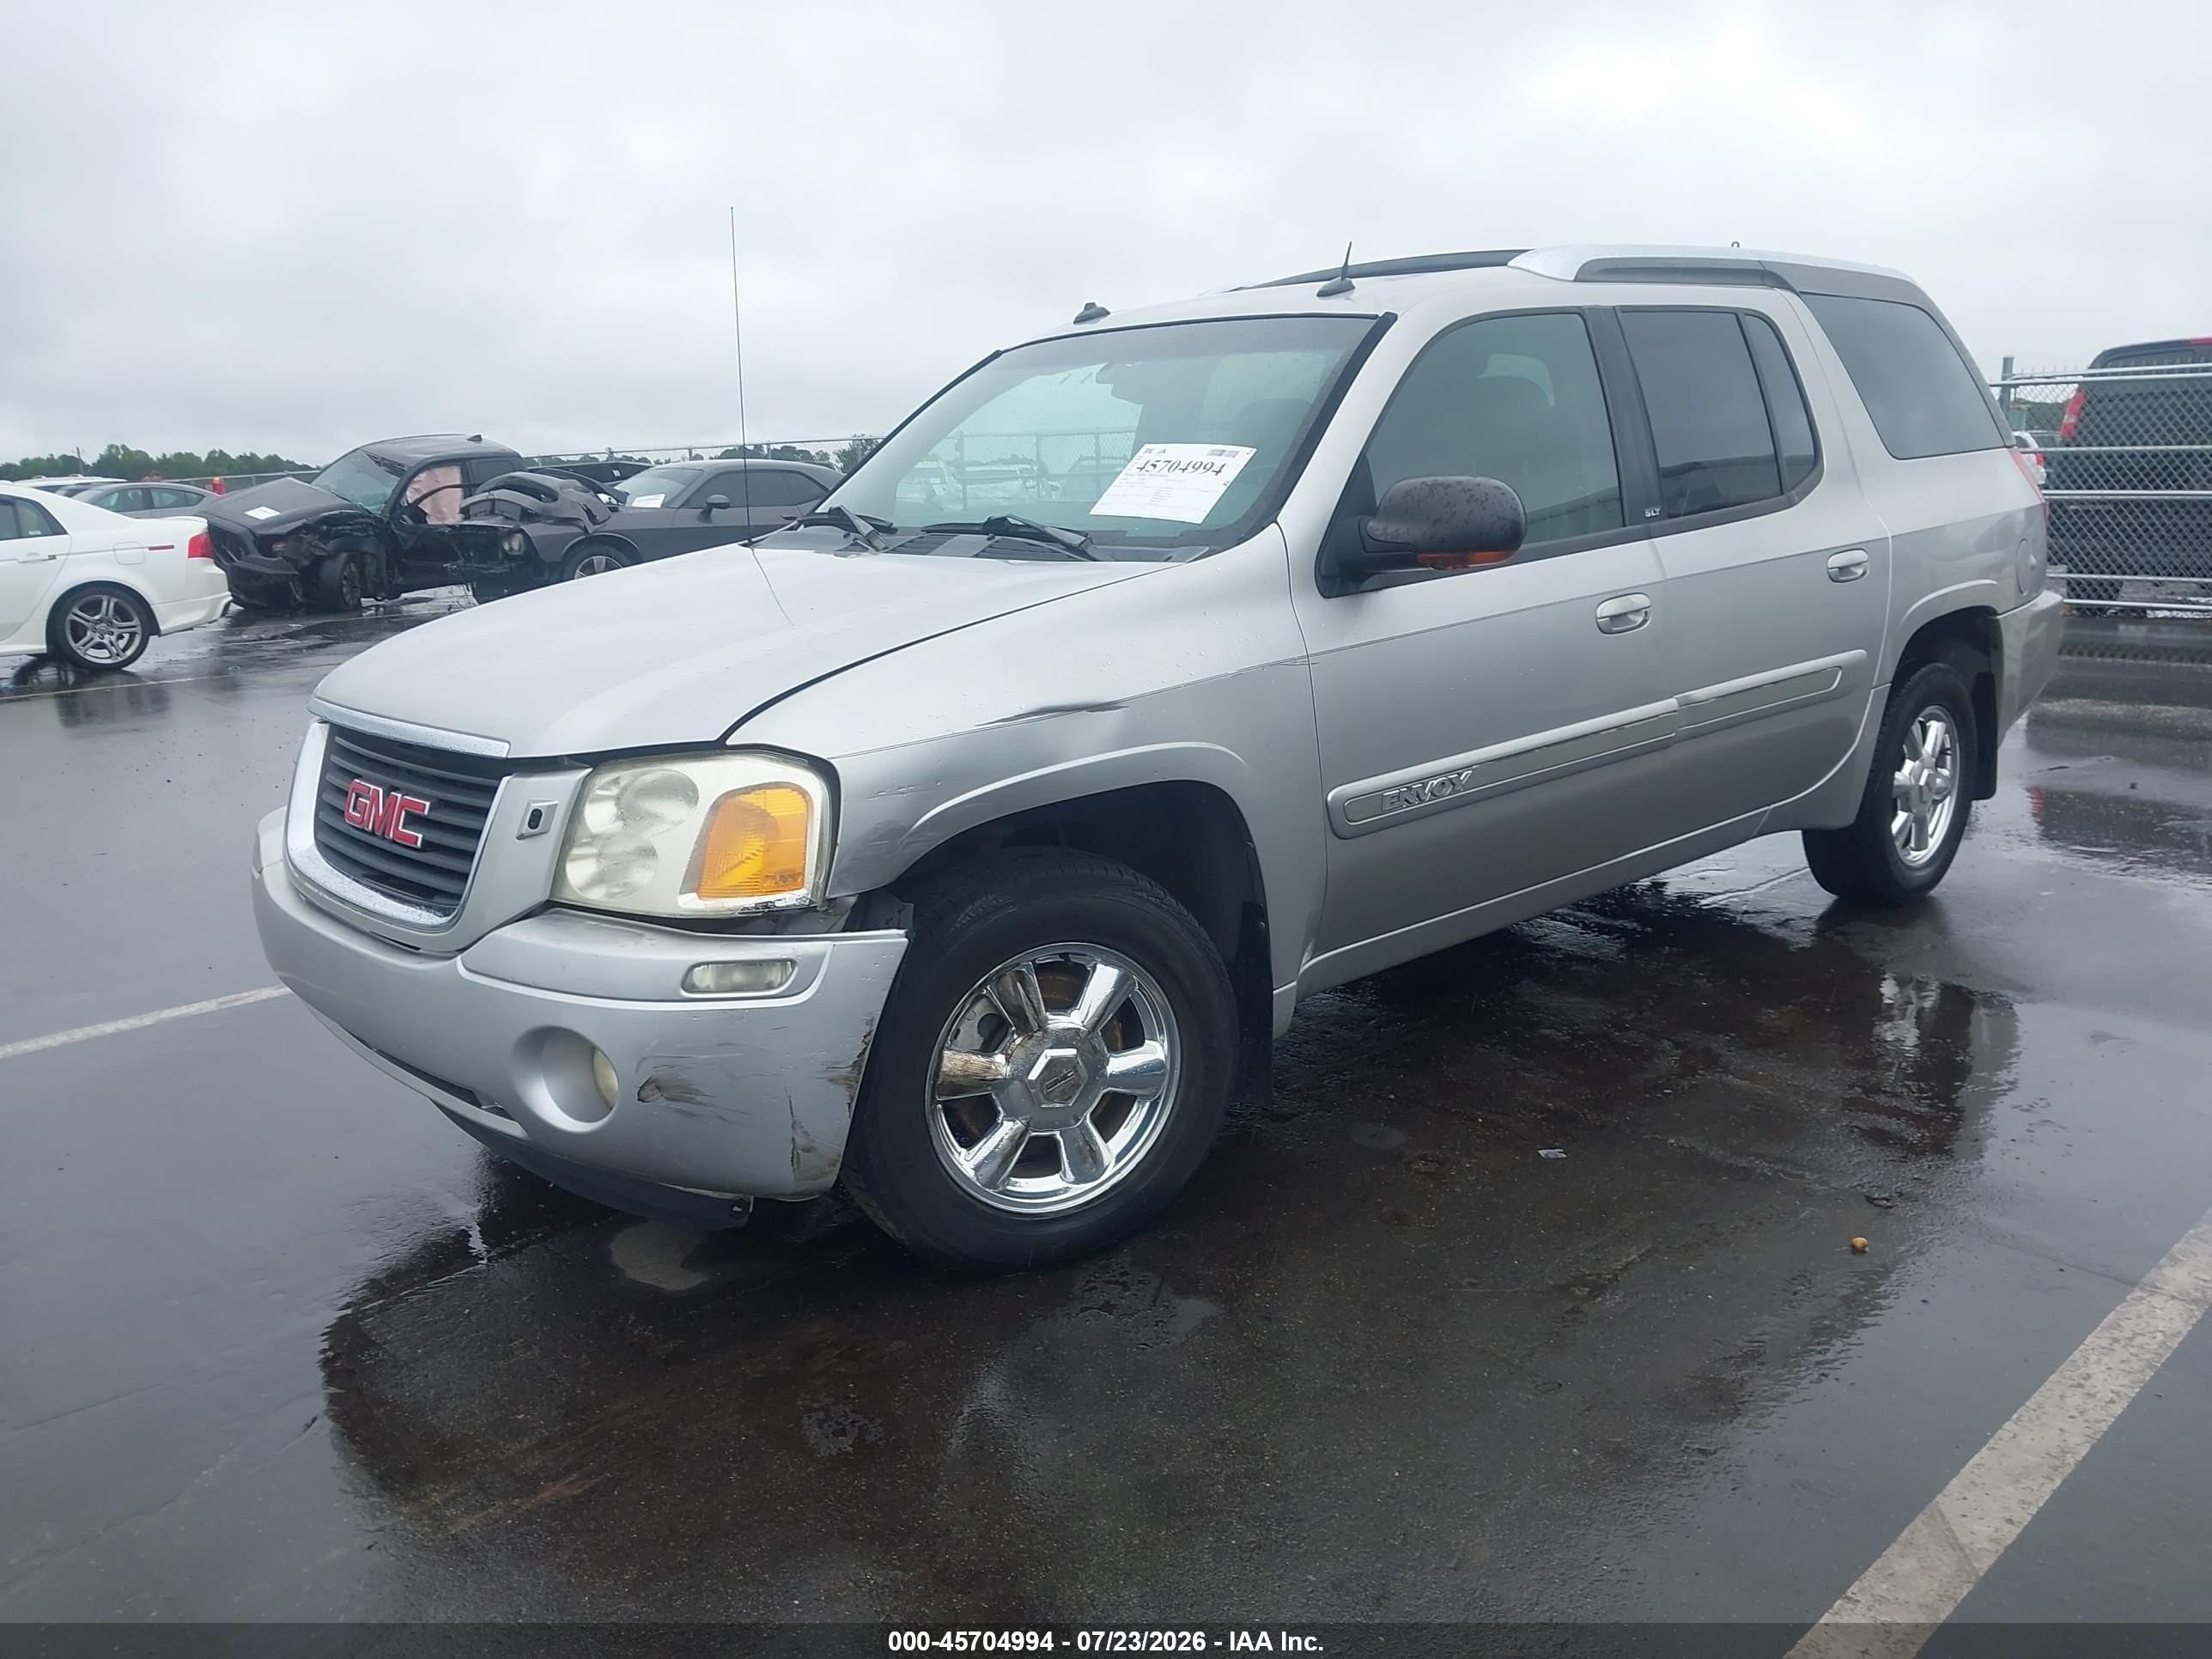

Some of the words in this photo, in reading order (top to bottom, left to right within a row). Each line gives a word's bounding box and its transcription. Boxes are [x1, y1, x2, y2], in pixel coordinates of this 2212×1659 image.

[1136, 459, 1226, 477] 45704994
[1644, 507, 1662, 517] SLT
[1382, 770, 1473, 811] ENVOY
[344, 778, 430, 849] GMC
